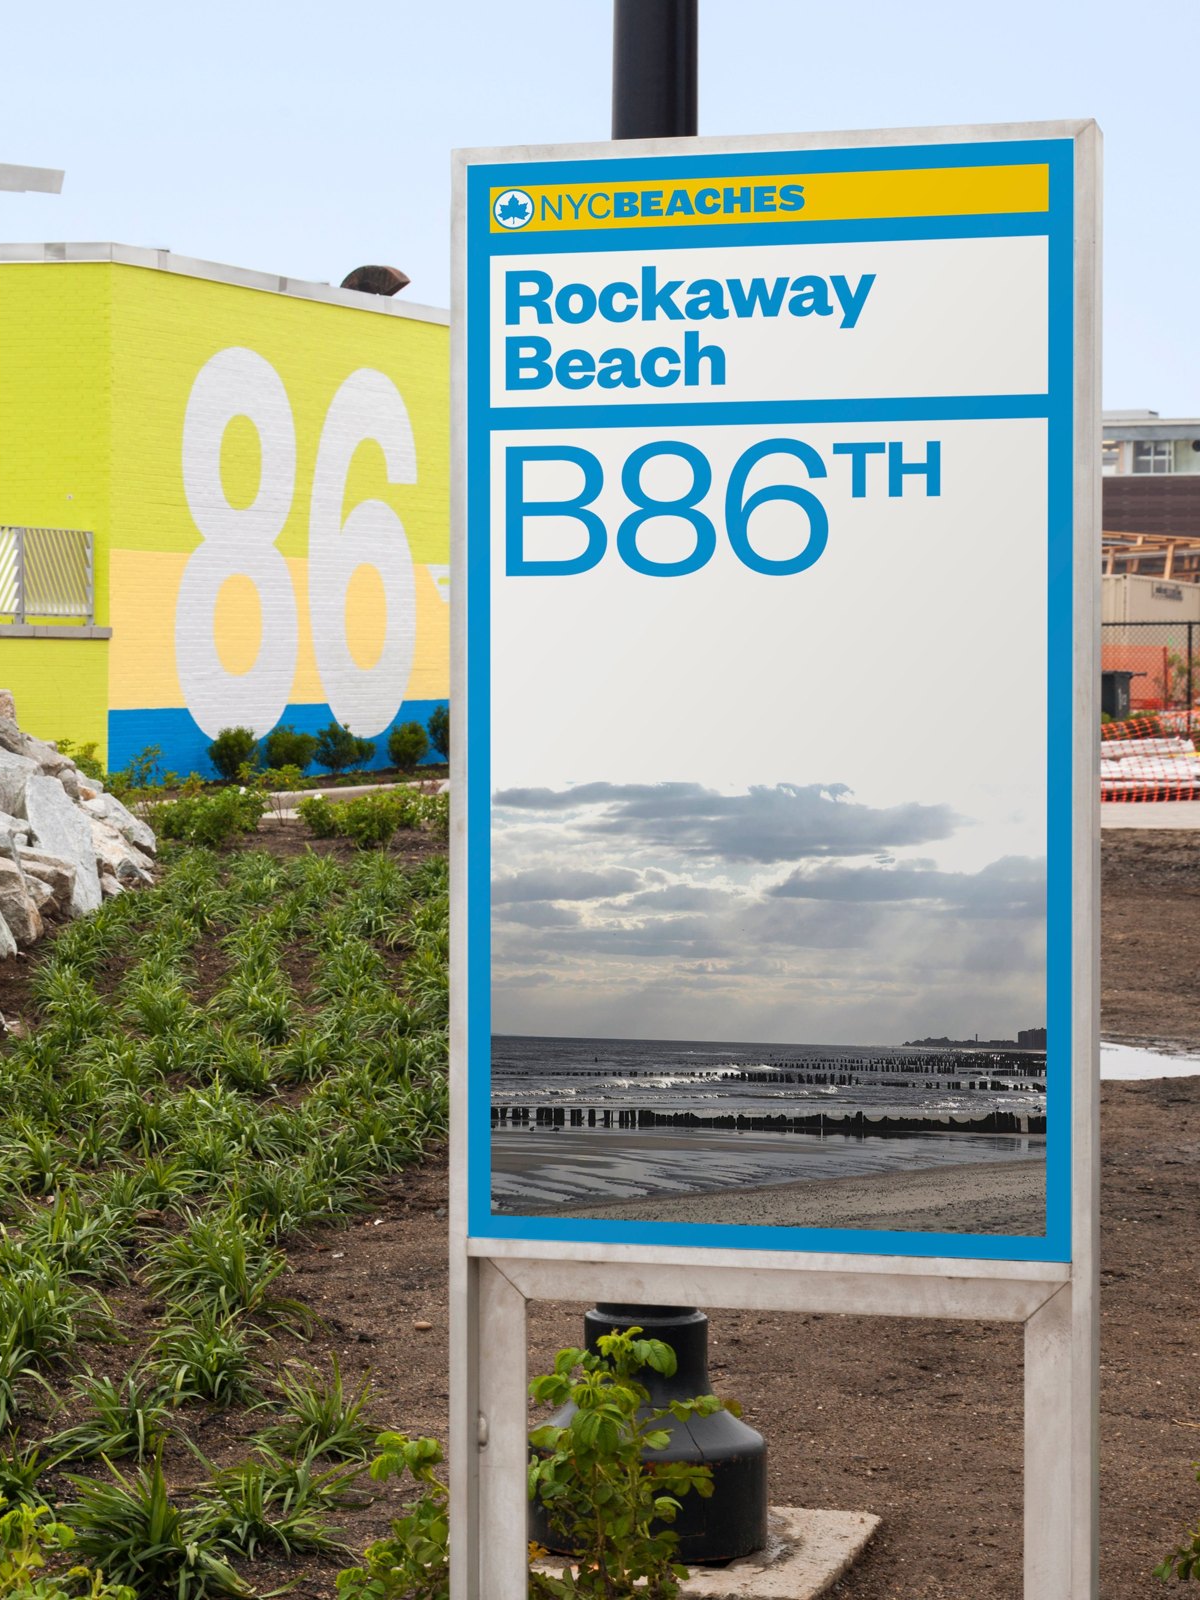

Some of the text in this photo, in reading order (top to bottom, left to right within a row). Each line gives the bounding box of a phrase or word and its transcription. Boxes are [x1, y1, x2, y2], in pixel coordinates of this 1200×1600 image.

[505, 265, 877, 329] Rockaway
[505, 330, 727, 391] Beach
[174, 346, 418, 744] 86
